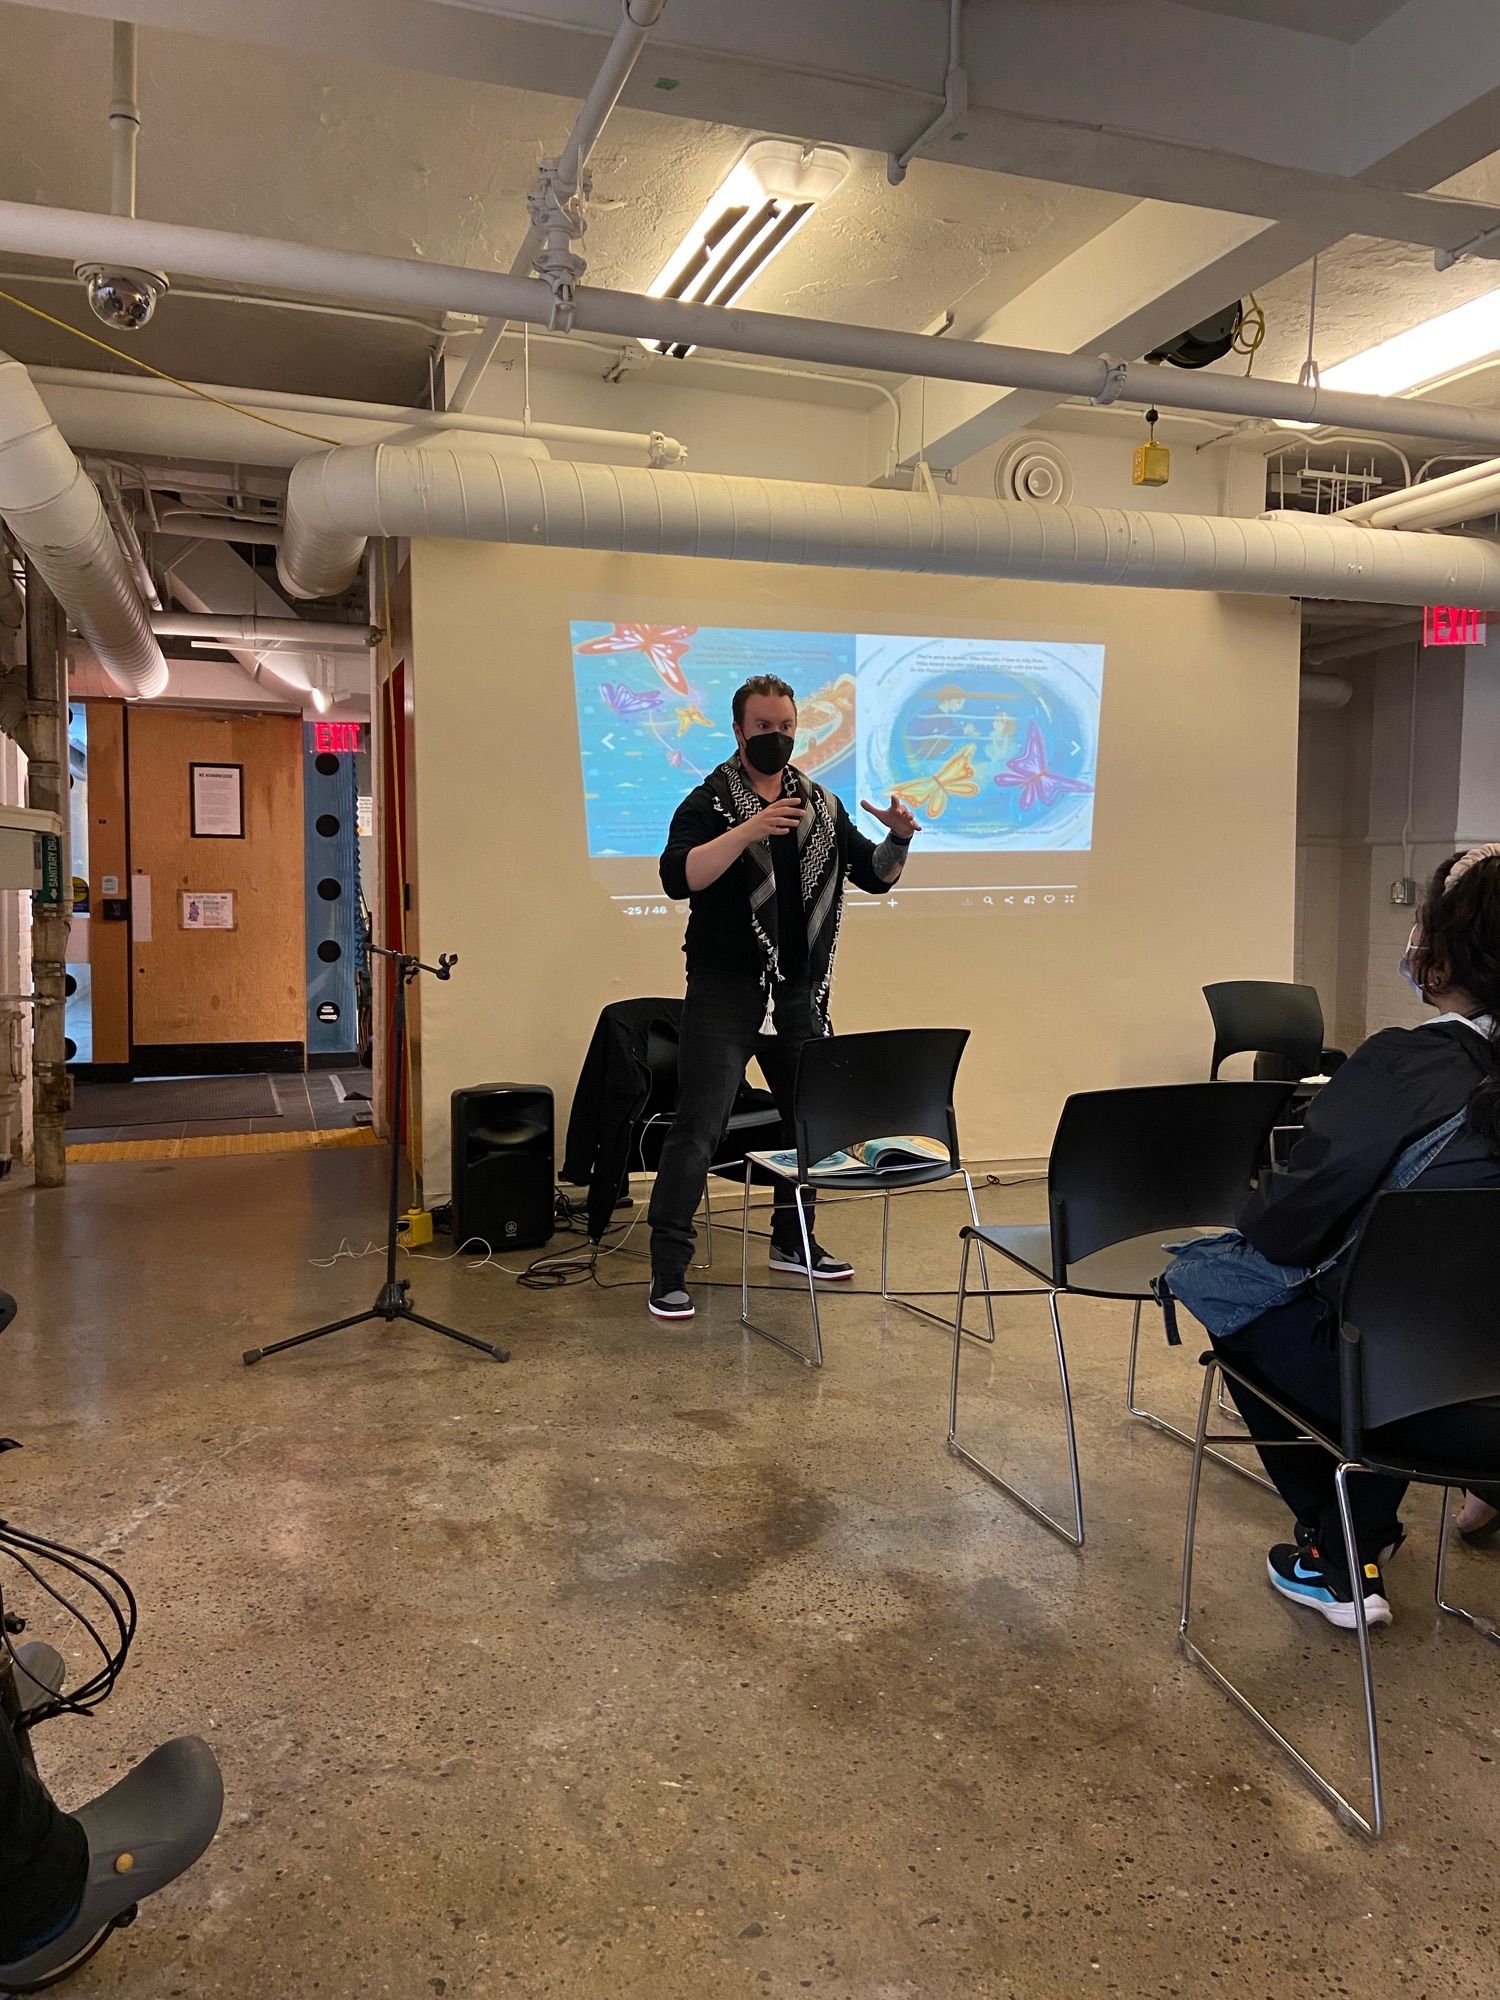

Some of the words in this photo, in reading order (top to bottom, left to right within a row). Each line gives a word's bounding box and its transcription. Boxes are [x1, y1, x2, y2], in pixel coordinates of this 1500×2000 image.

[1433, 605, 1481, 645] EXIT
[315, 723, 360, 753] EXIT
[47, 852, 59, 888] SANITARY
